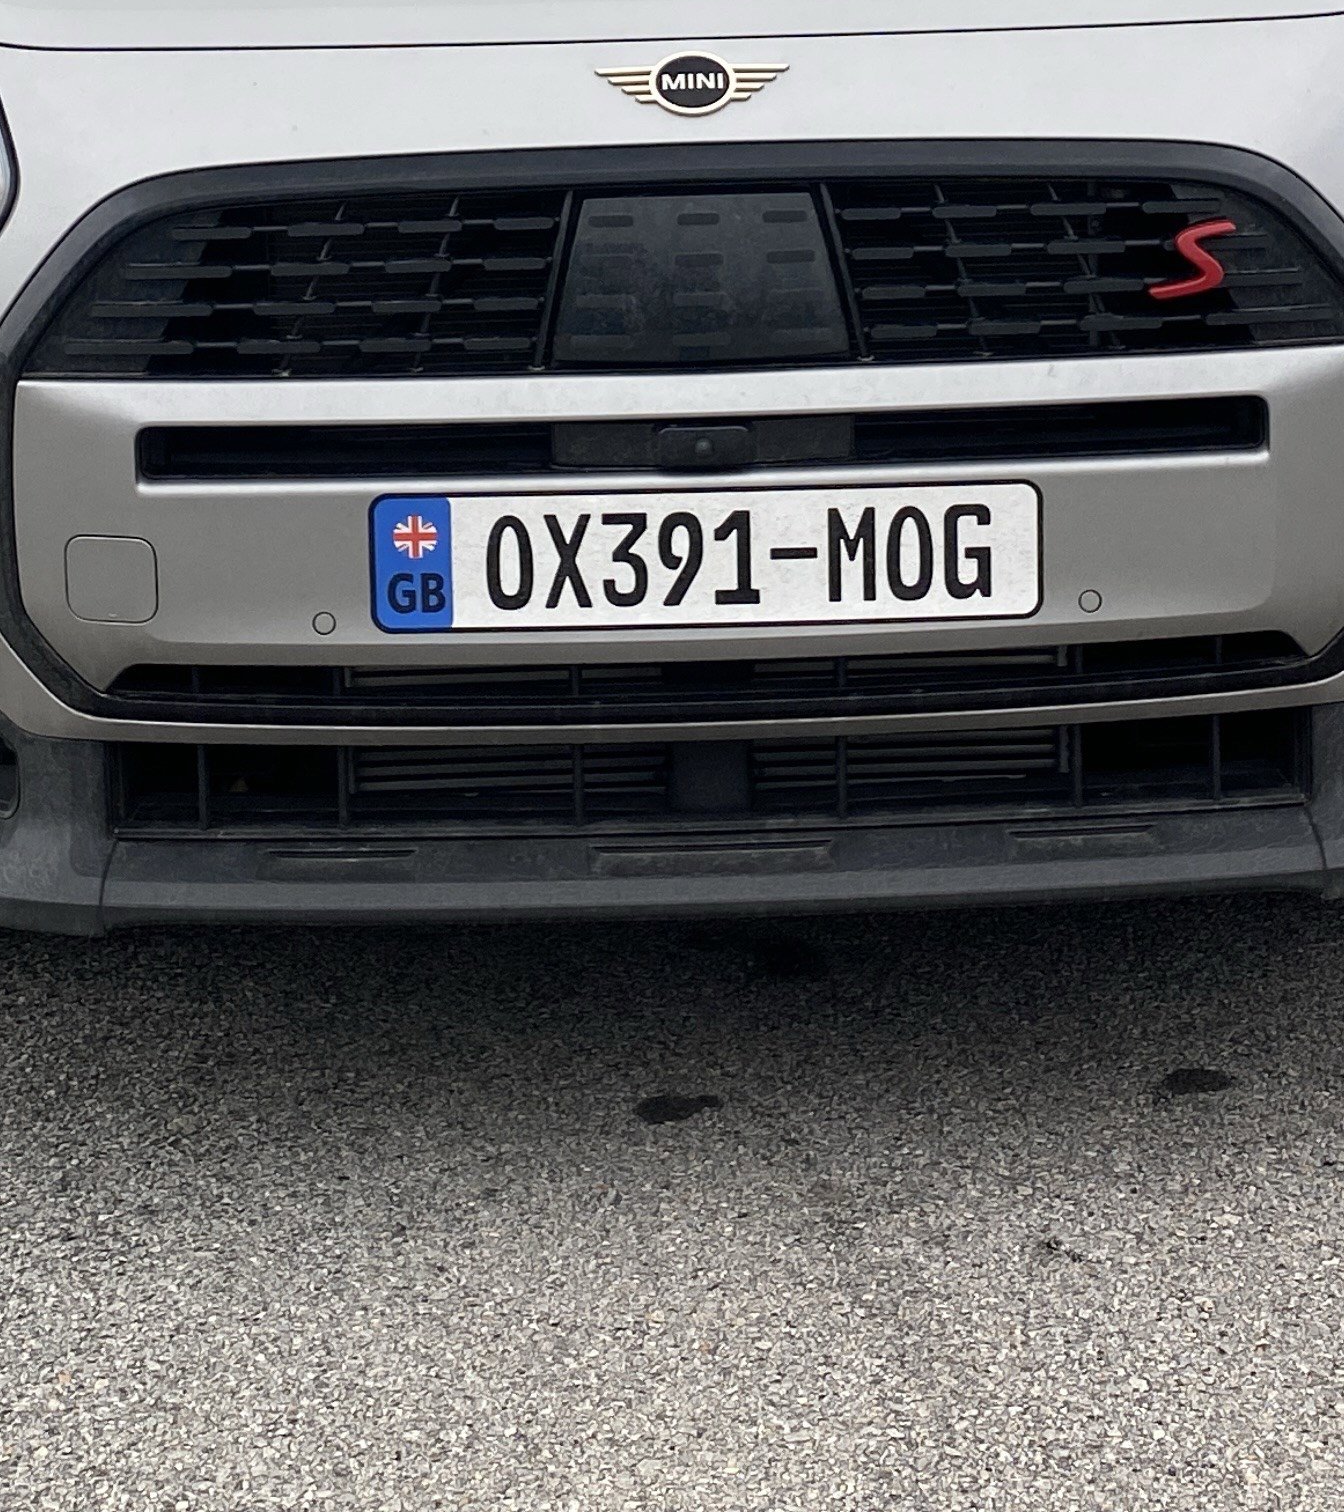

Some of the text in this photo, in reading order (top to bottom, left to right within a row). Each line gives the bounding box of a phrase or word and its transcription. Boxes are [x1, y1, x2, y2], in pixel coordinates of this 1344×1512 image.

[661, 72, 724, 90] MINI
[1148, 219, 1236, 299] S
[388, 573, 446, 614] GB
